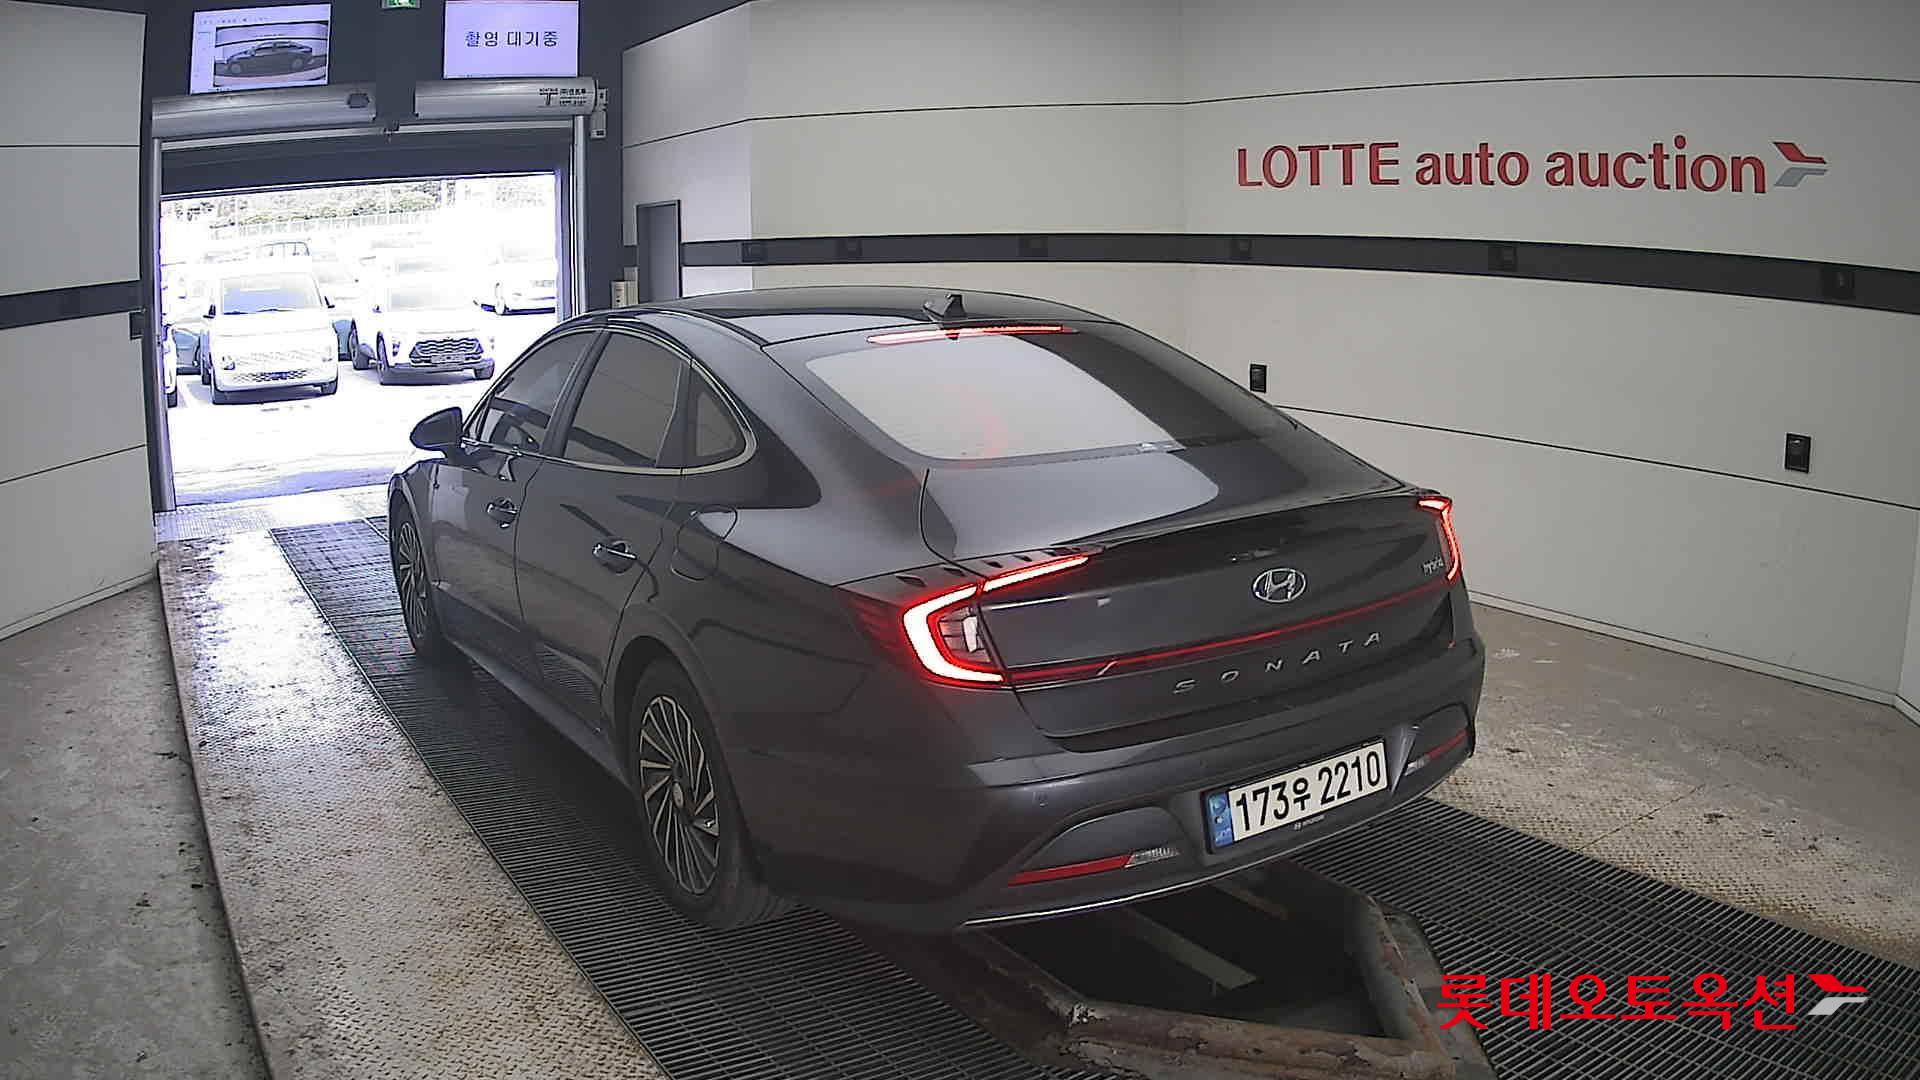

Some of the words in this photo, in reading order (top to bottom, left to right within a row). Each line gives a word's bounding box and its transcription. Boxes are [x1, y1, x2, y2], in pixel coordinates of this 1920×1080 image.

[1237, 142, 1400, 188] LOTTE
[1415, 143, 1530, 186] auto
[1545, 136, 1767, 194] auction
[1173, 632, 1381, 694] SONATA
[1236, 777, 1311, 831] 173우
[1318, 751, 1381, 805] 2210
